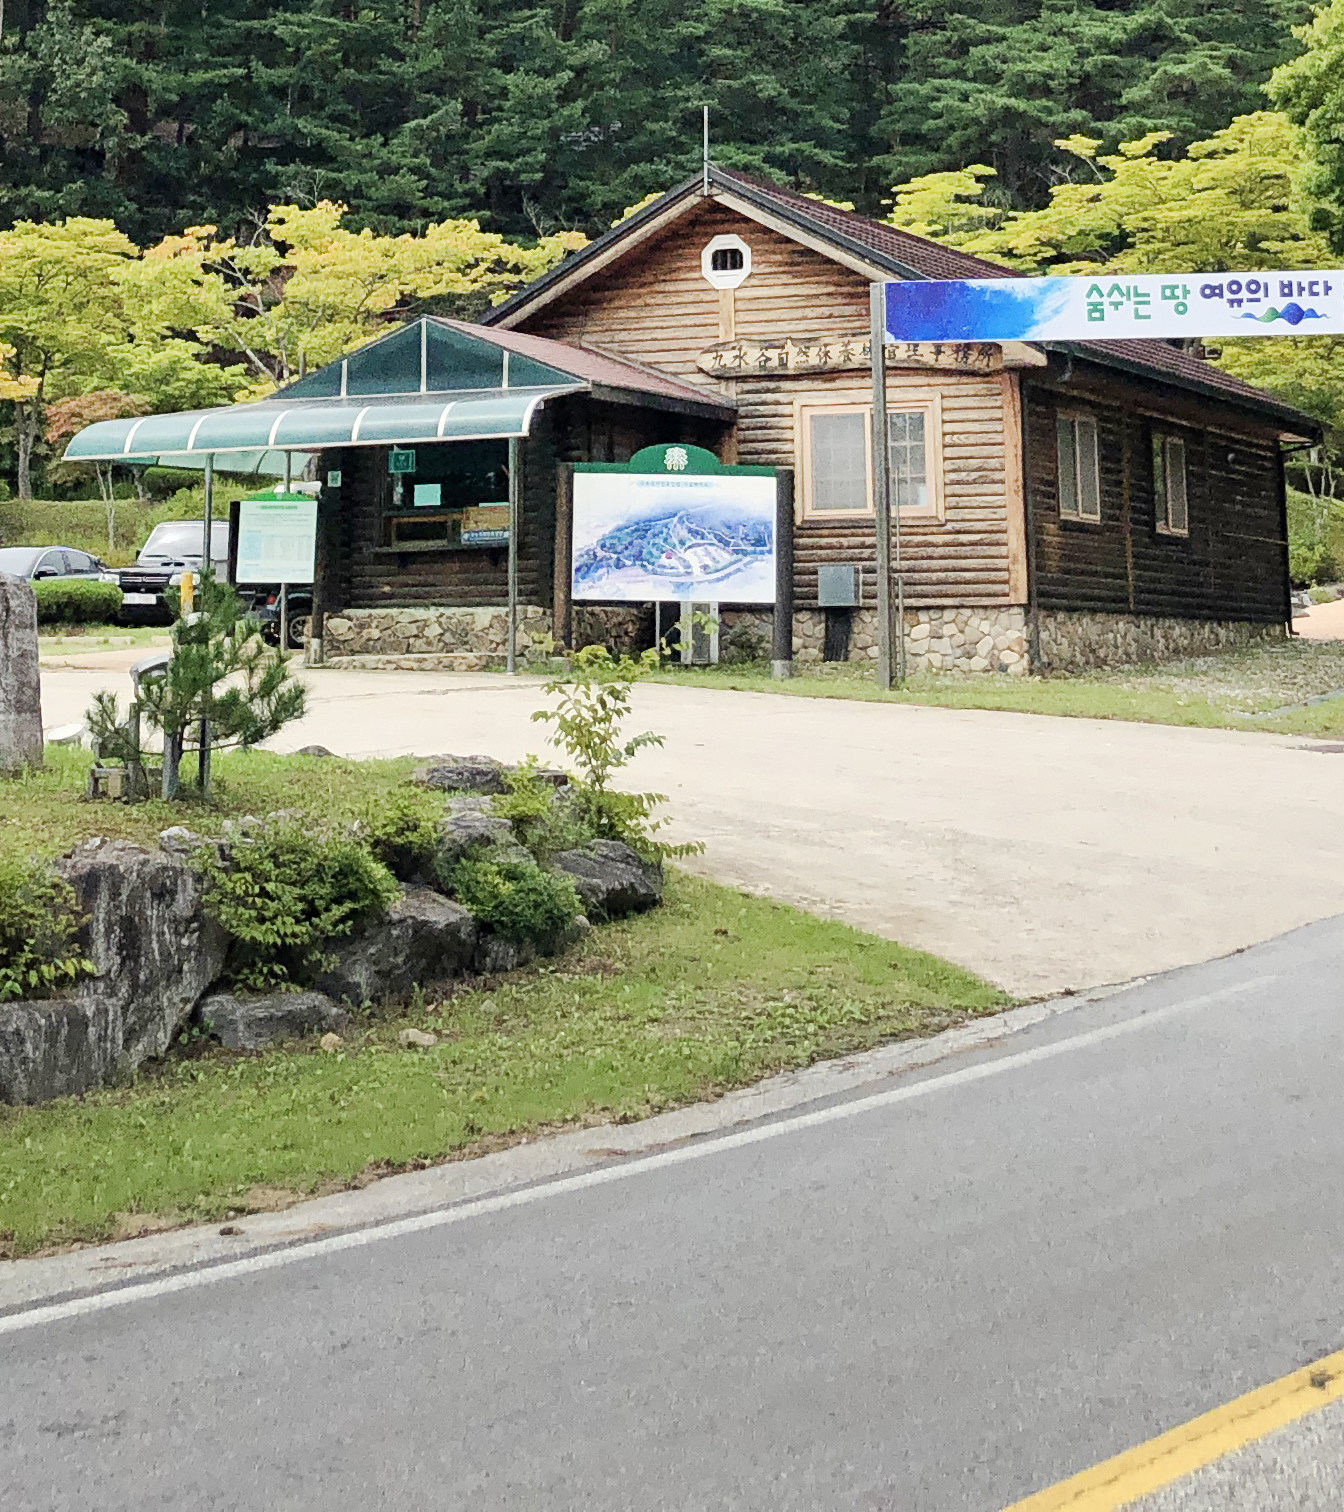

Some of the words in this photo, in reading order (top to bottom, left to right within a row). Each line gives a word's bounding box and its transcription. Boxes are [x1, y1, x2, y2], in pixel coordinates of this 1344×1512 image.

[1085, 283, 1152, 322] 숨쉬는
[1160, 283, 1191, 315] 땅
[1199, 278, 1269, 308] 여유의
[1279, 279, 1333, 298] 바다
